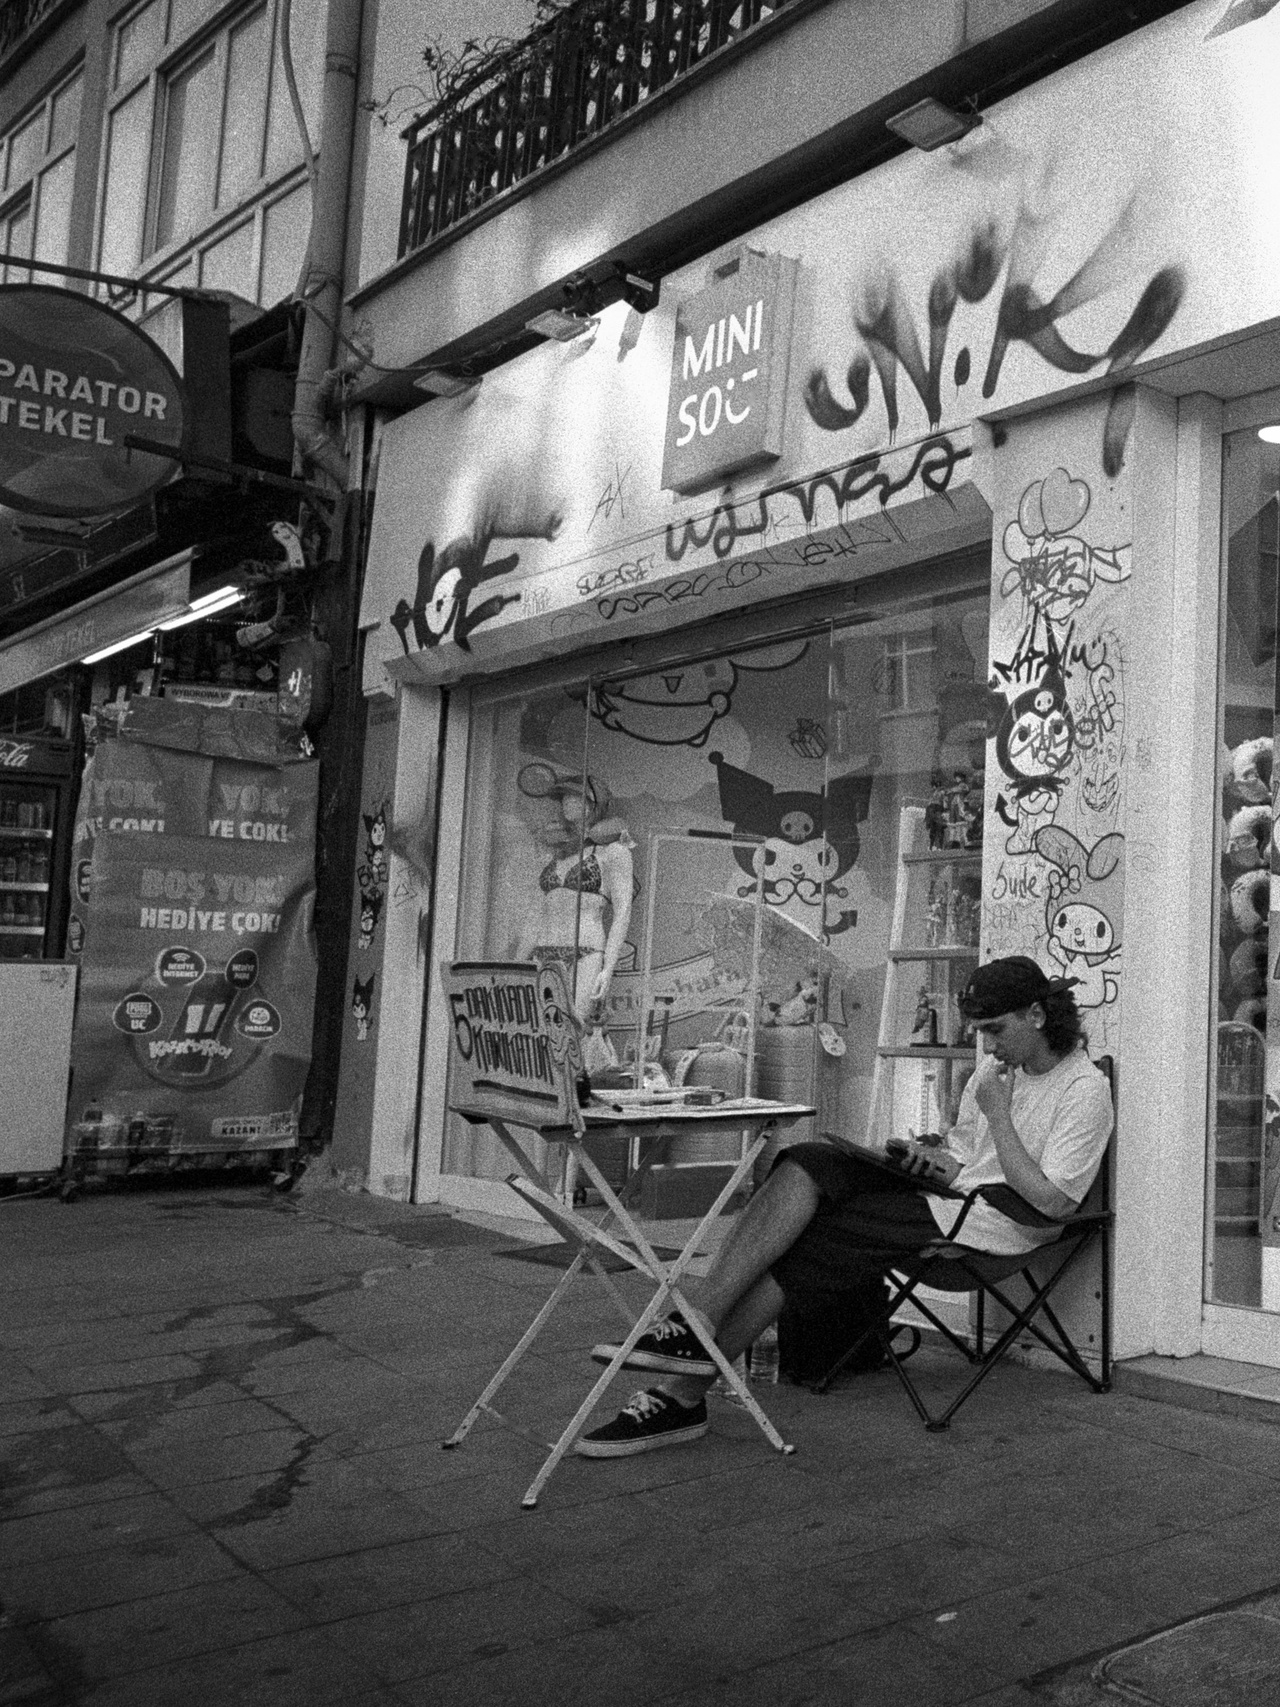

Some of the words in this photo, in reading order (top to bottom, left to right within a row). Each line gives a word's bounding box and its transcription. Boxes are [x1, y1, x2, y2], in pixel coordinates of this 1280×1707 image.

[682, 300, 763, 380] MINI
[140, 905, 226, 932] HEDİYE
[231, 911, 282, 936] ÇOK!
[449, 994, 473, 1061] 5
